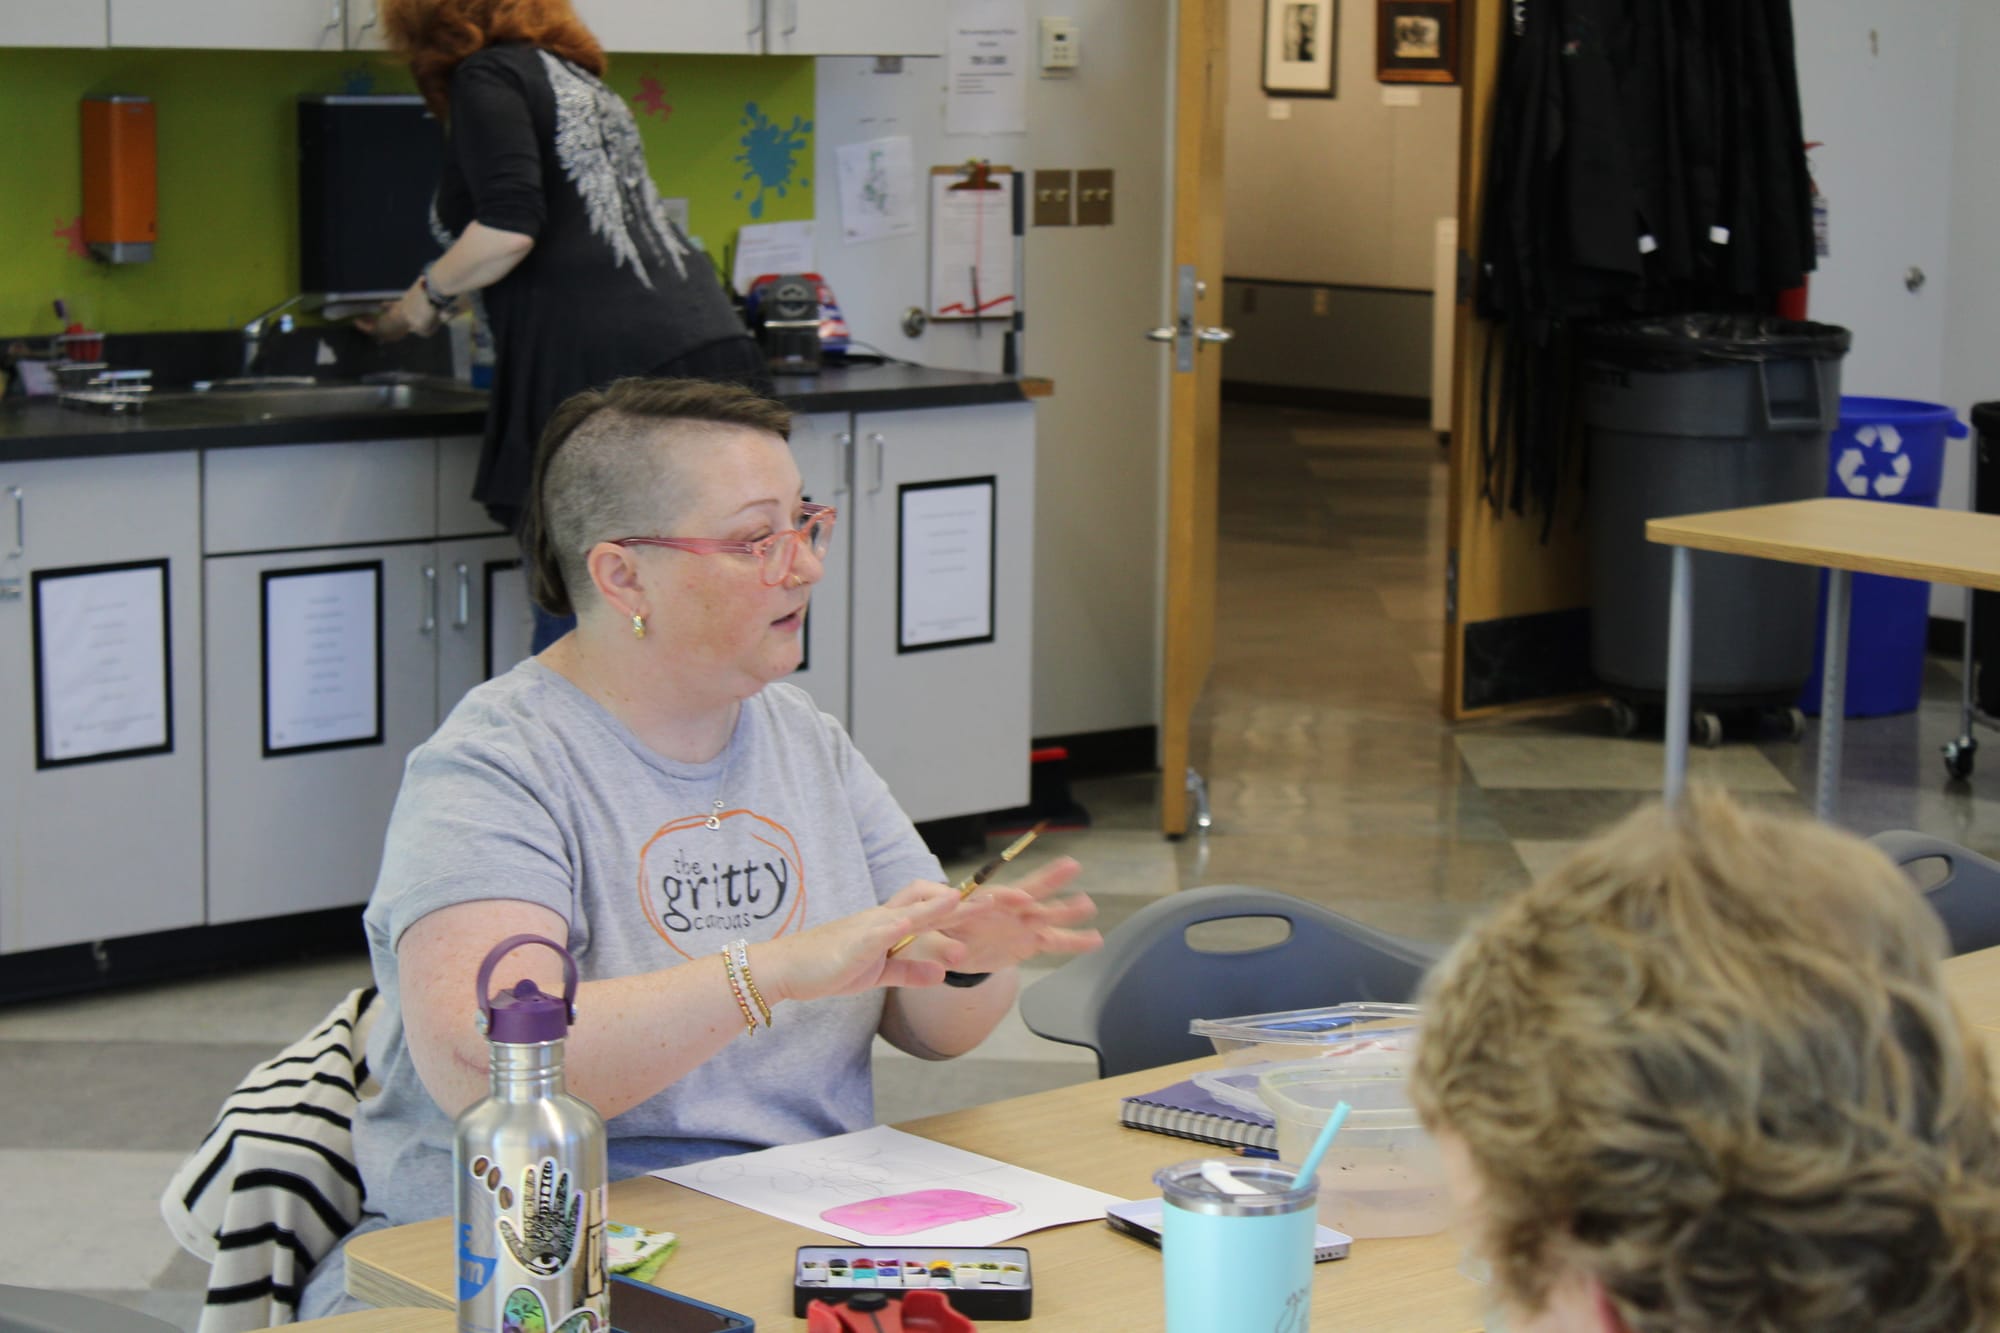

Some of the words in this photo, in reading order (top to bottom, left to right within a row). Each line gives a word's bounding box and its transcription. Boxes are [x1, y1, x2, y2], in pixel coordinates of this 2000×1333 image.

[673, 848, 703, 875] the
[662, 857, 788, 932] gritty
[693, 912, 751, 931] canvas
